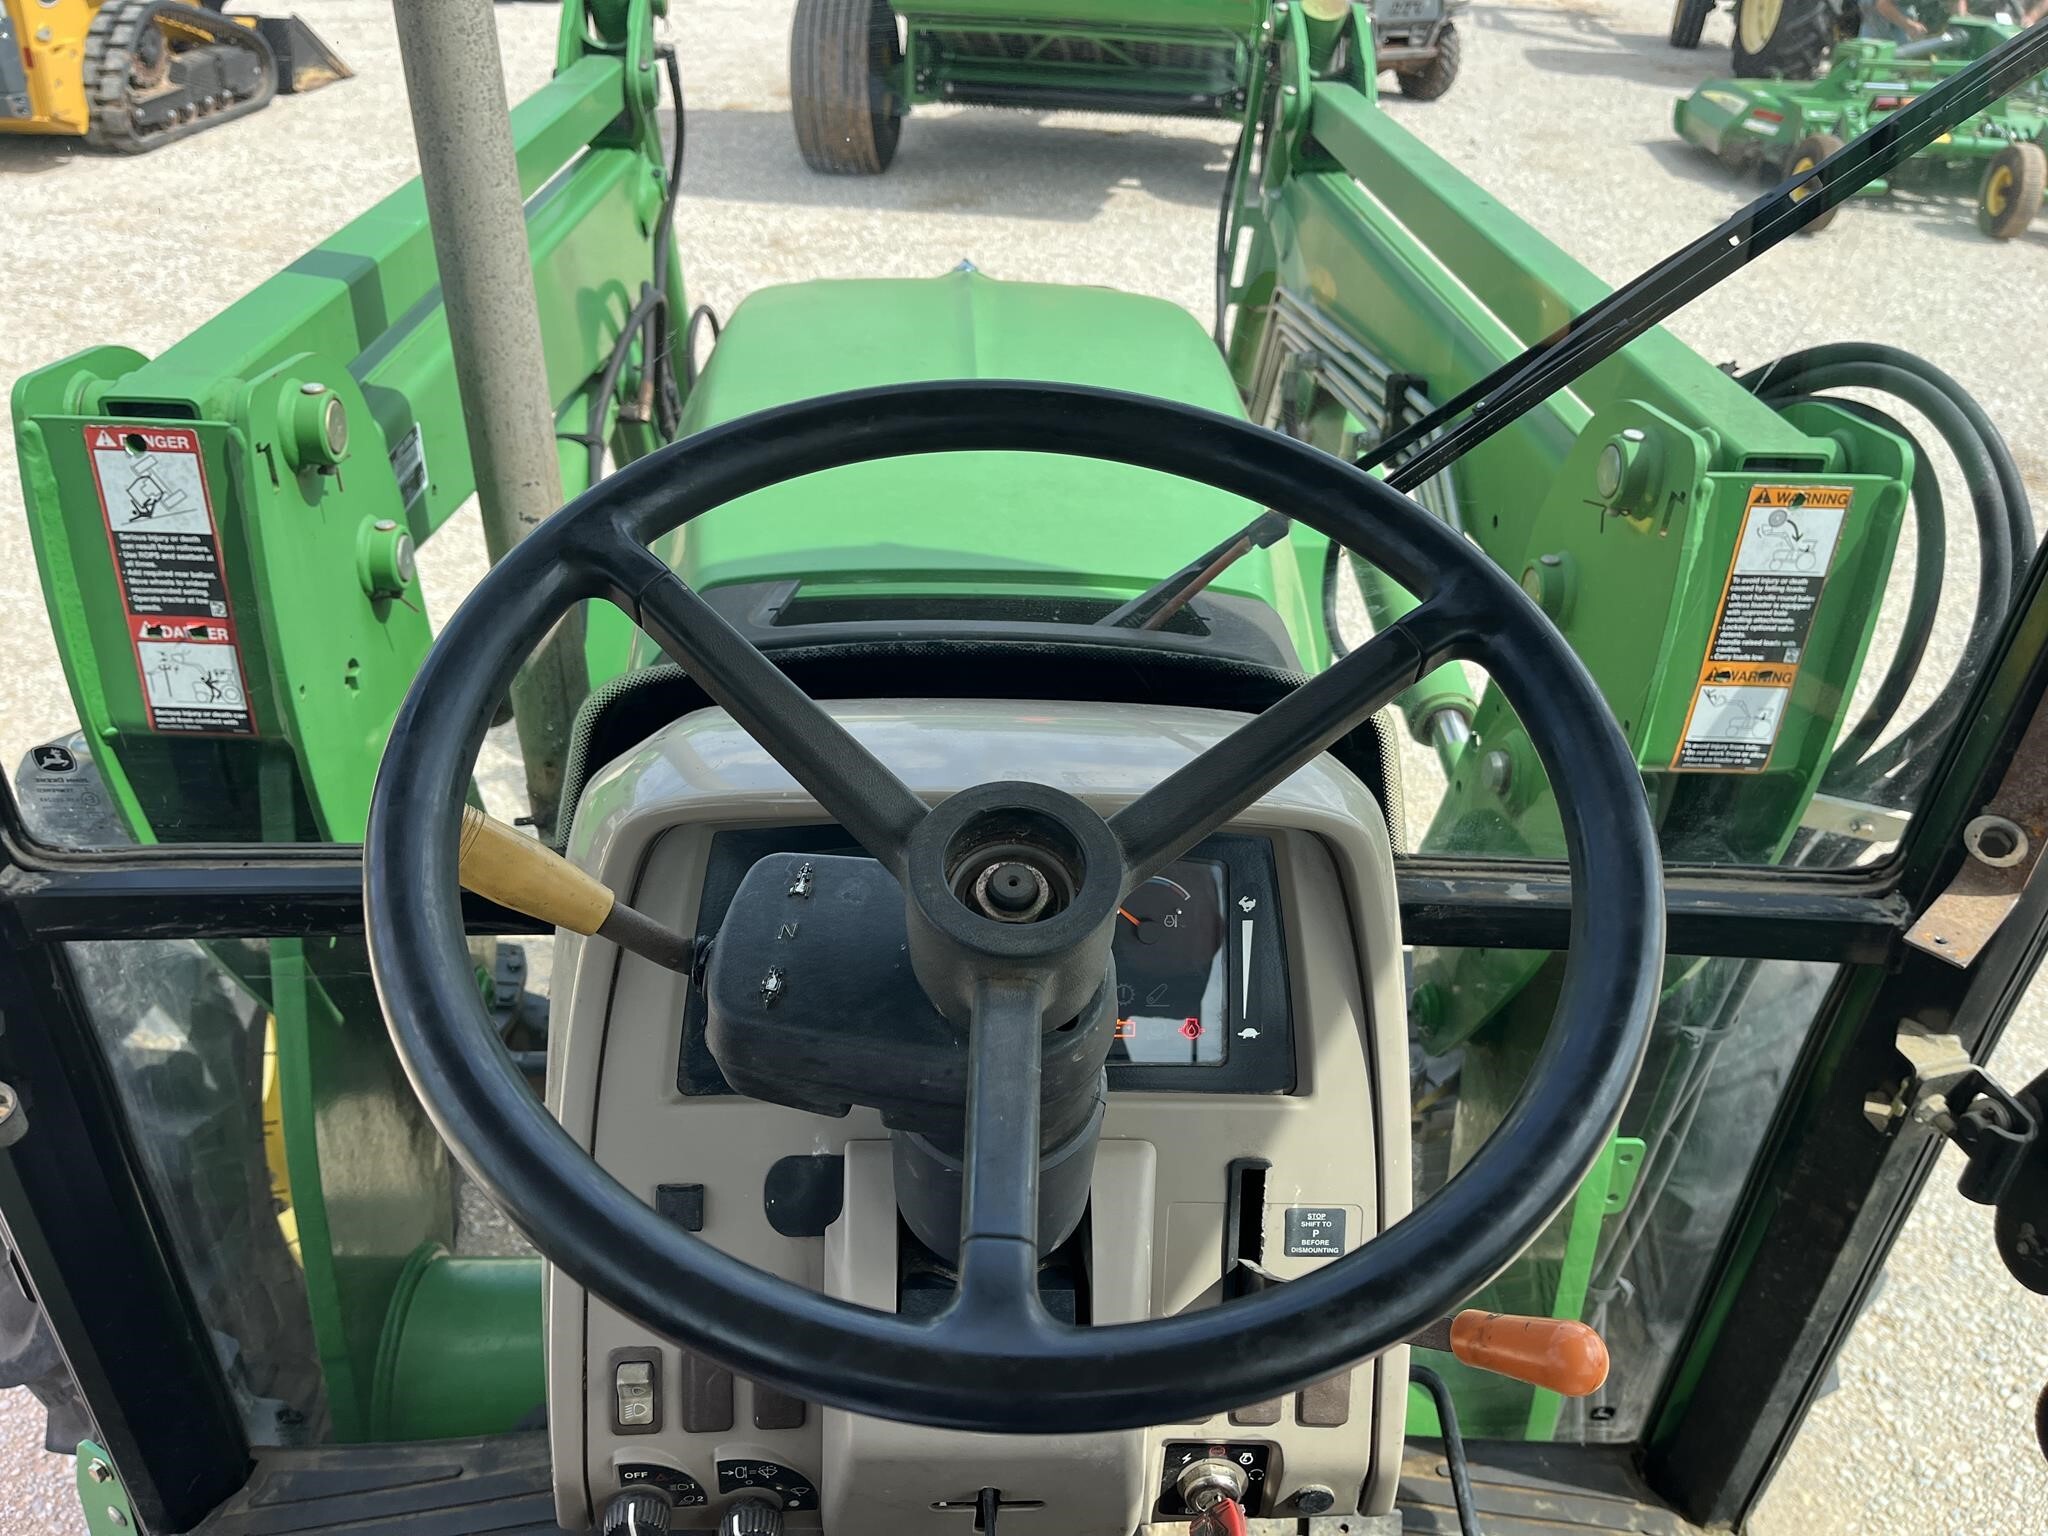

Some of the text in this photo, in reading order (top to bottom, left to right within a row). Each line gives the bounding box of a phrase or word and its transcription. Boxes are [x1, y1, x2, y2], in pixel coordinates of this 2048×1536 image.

[118, 434, 190, 449] DNGER
[119, 533, 146, 541] Serious
[147, 534, 169, 543] injury
[180, 535, 201, 543] death
[138, 552, 160, 560] ROPS
[150, 578, 175, 586] wheels
[1733, 576, 1740, 584] To
[1761, 577, 1779, 586] injury
[1755, 585, 1764, 593] by
[133, 595, 161, 603] Operate
[1731, 593, 1740, 601] Do
[777, 922, 798, 939] N
